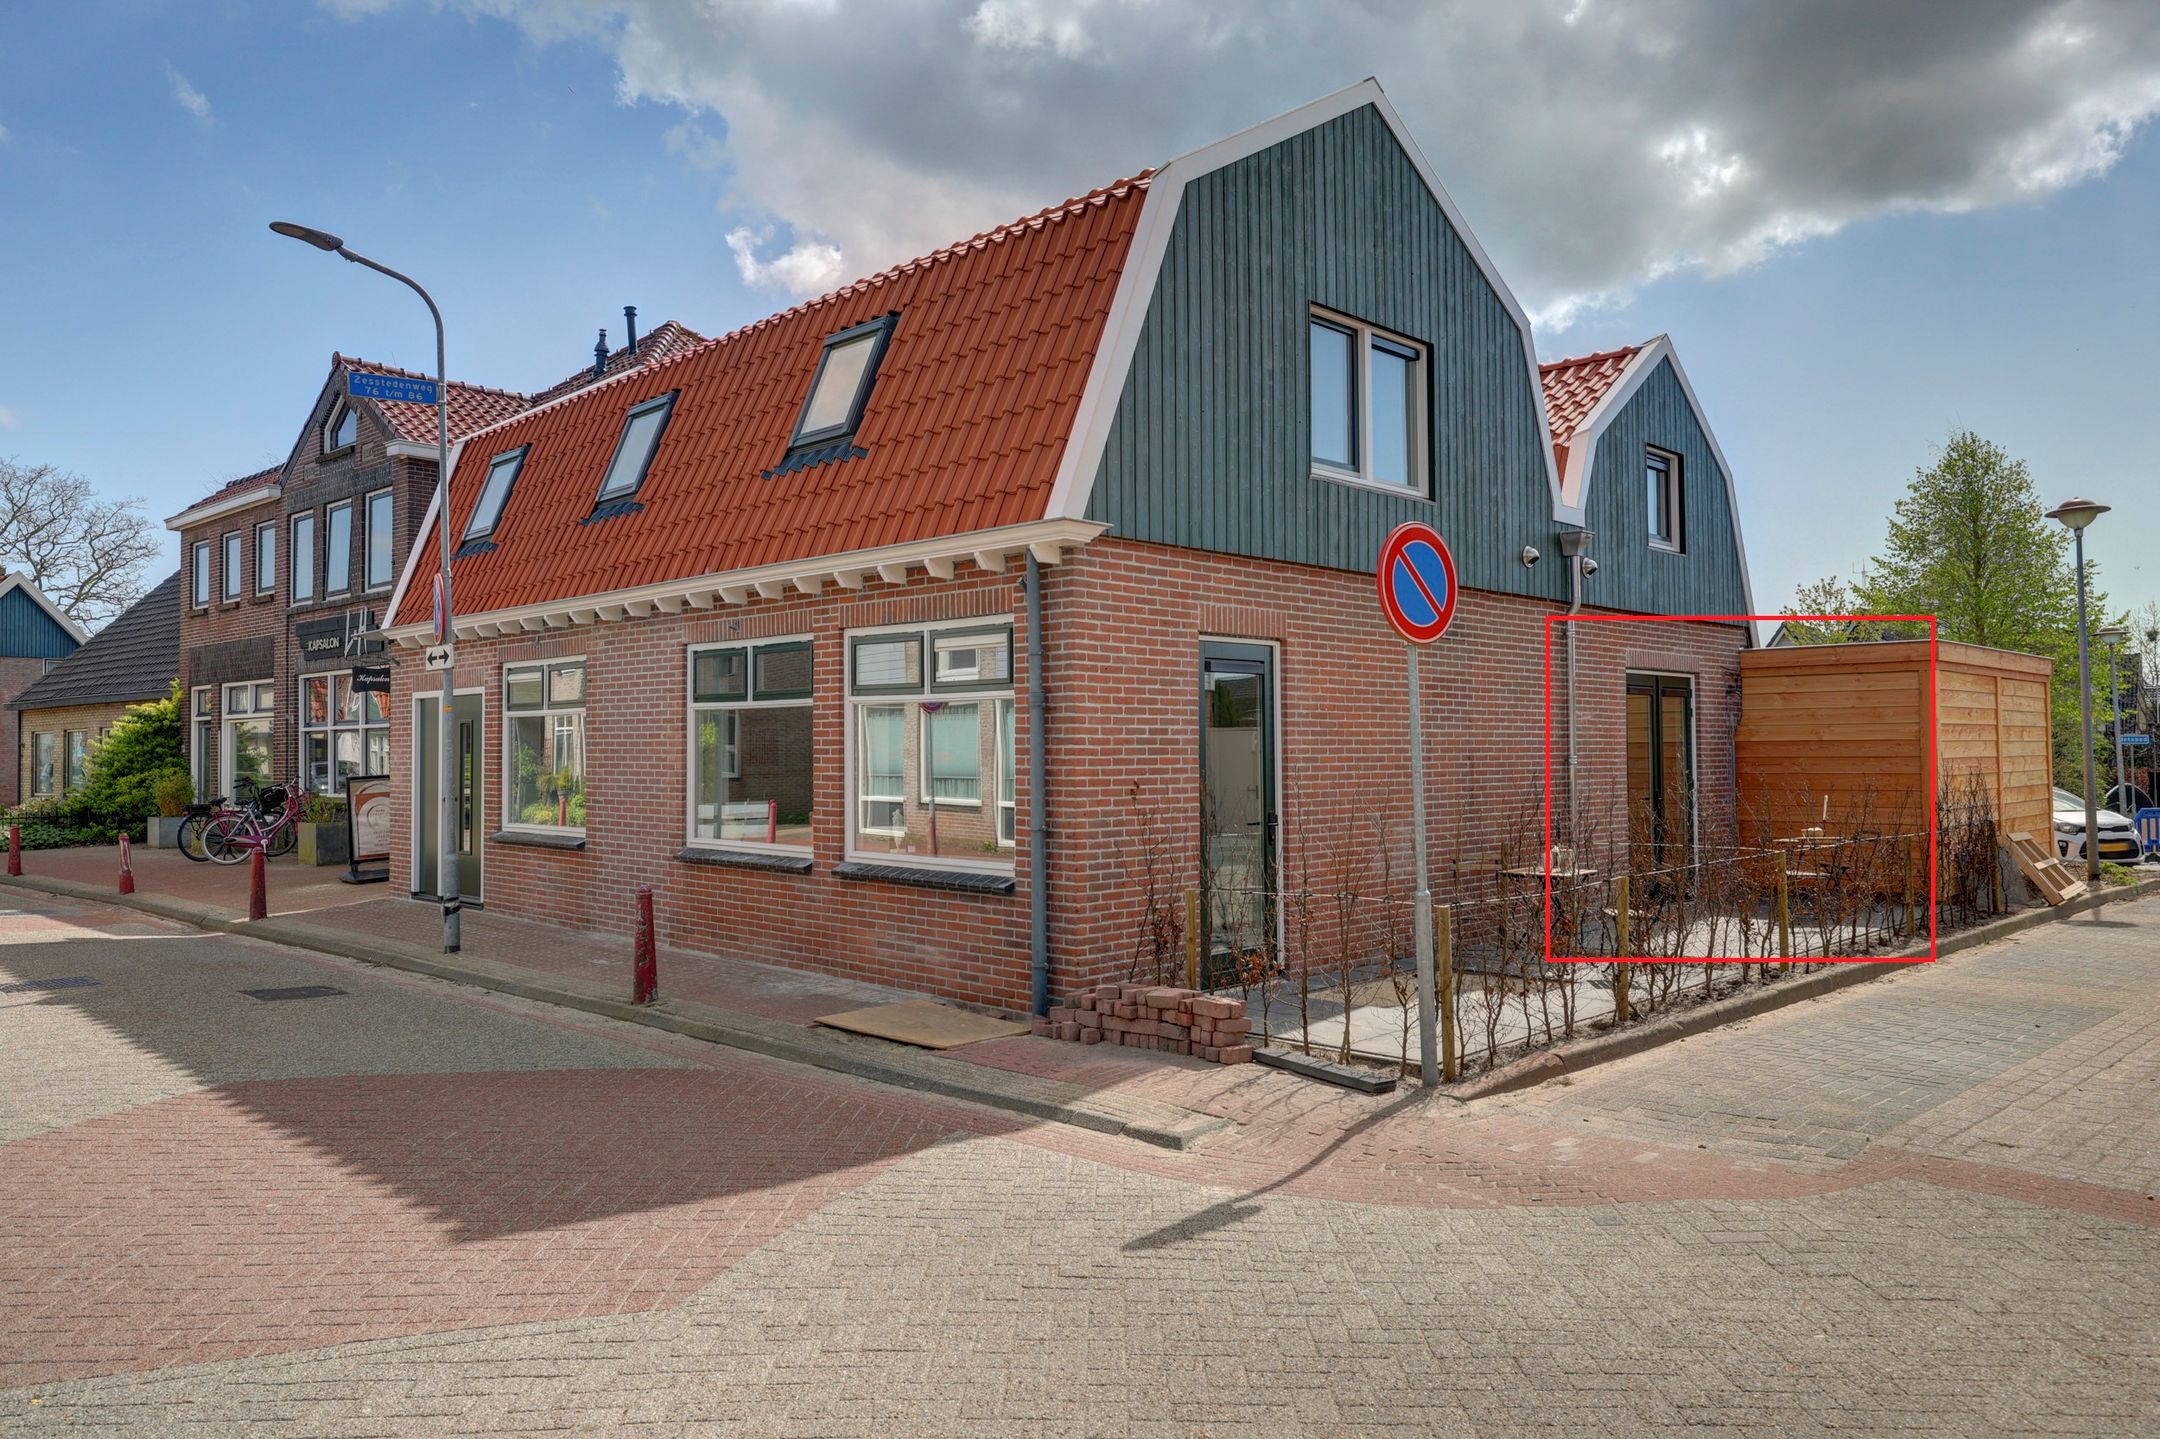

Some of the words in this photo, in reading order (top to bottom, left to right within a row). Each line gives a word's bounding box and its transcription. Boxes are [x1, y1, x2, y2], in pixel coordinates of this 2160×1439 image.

[354, 375, 432, 394] Zesstedenweg
[364, 386, 379, 396] 76
[385, 388, 403, 398] t/m
[308, 637, 340, 652] KAPSALON
[356, 674, 390, 684] Kapsalon
